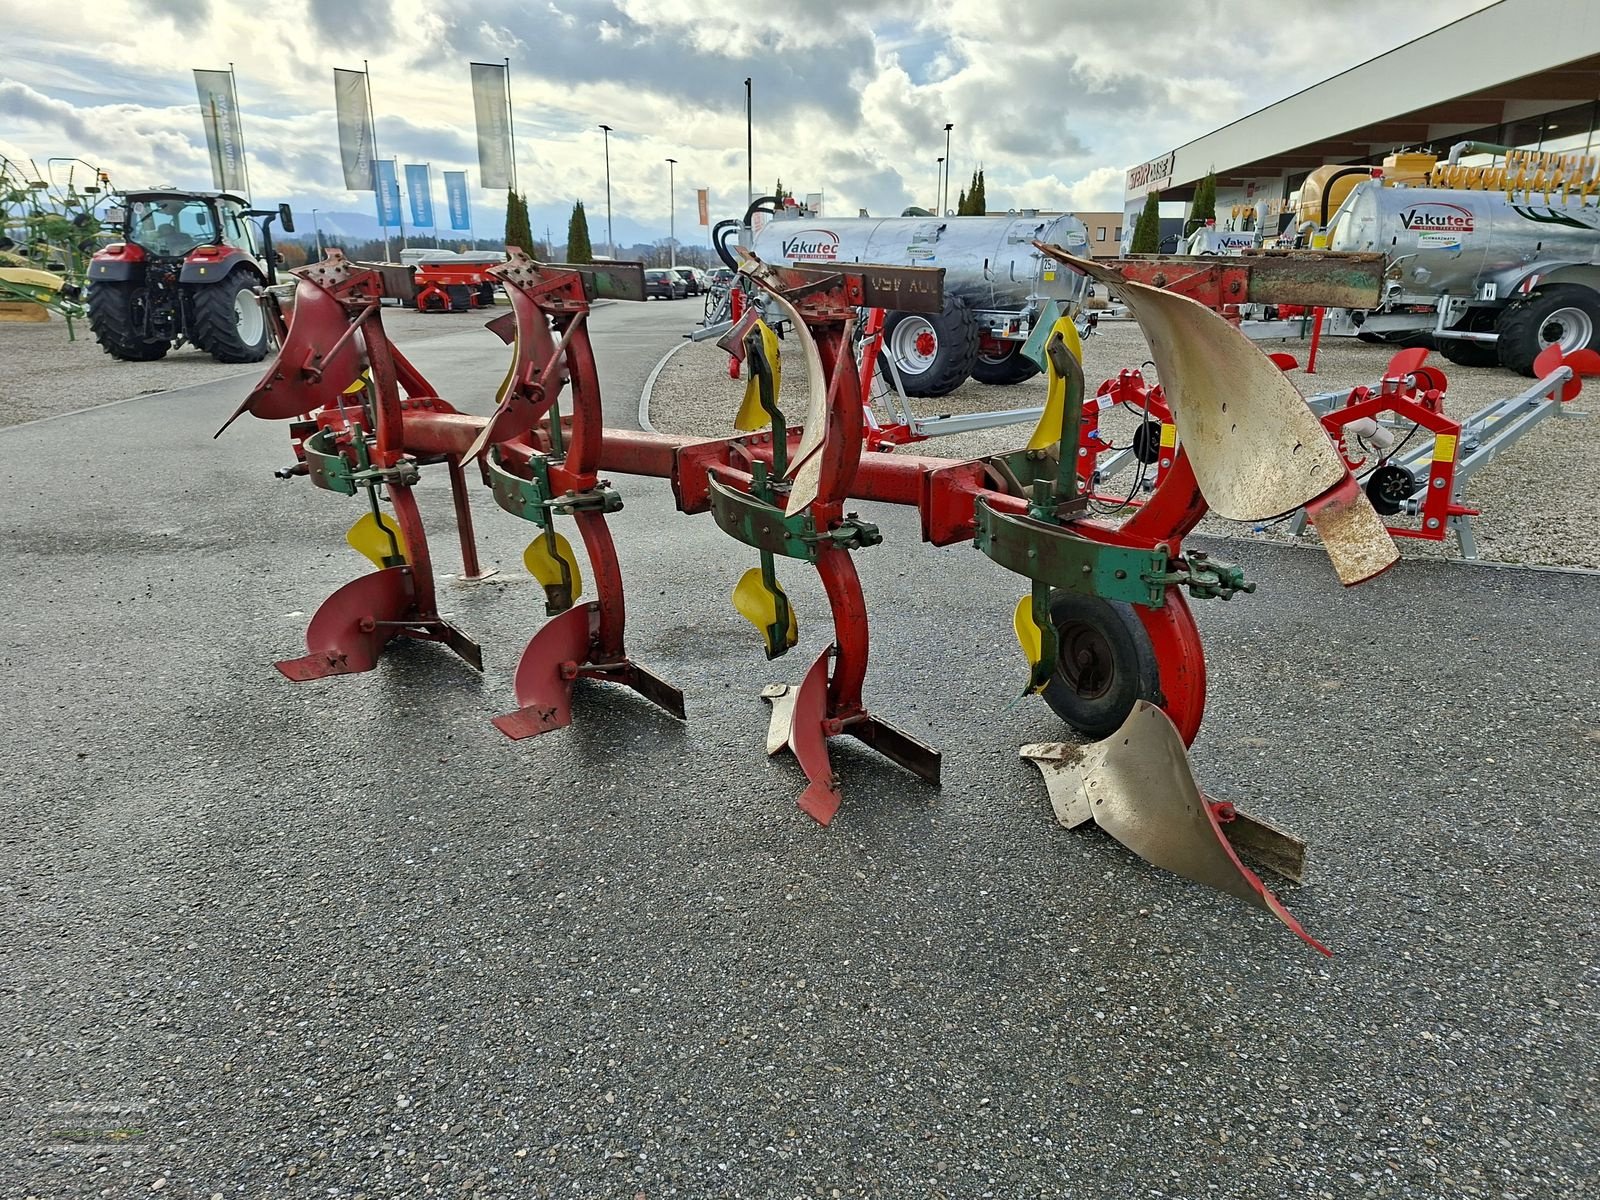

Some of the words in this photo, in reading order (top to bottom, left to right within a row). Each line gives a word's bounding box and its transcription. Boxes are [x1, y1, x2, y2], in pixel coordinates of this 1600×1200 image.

[1399, 209, 1474, 229] Vakutec
[782, 236, 838, 258] Vakutec
[1043, 259, 1052, 270] 25
